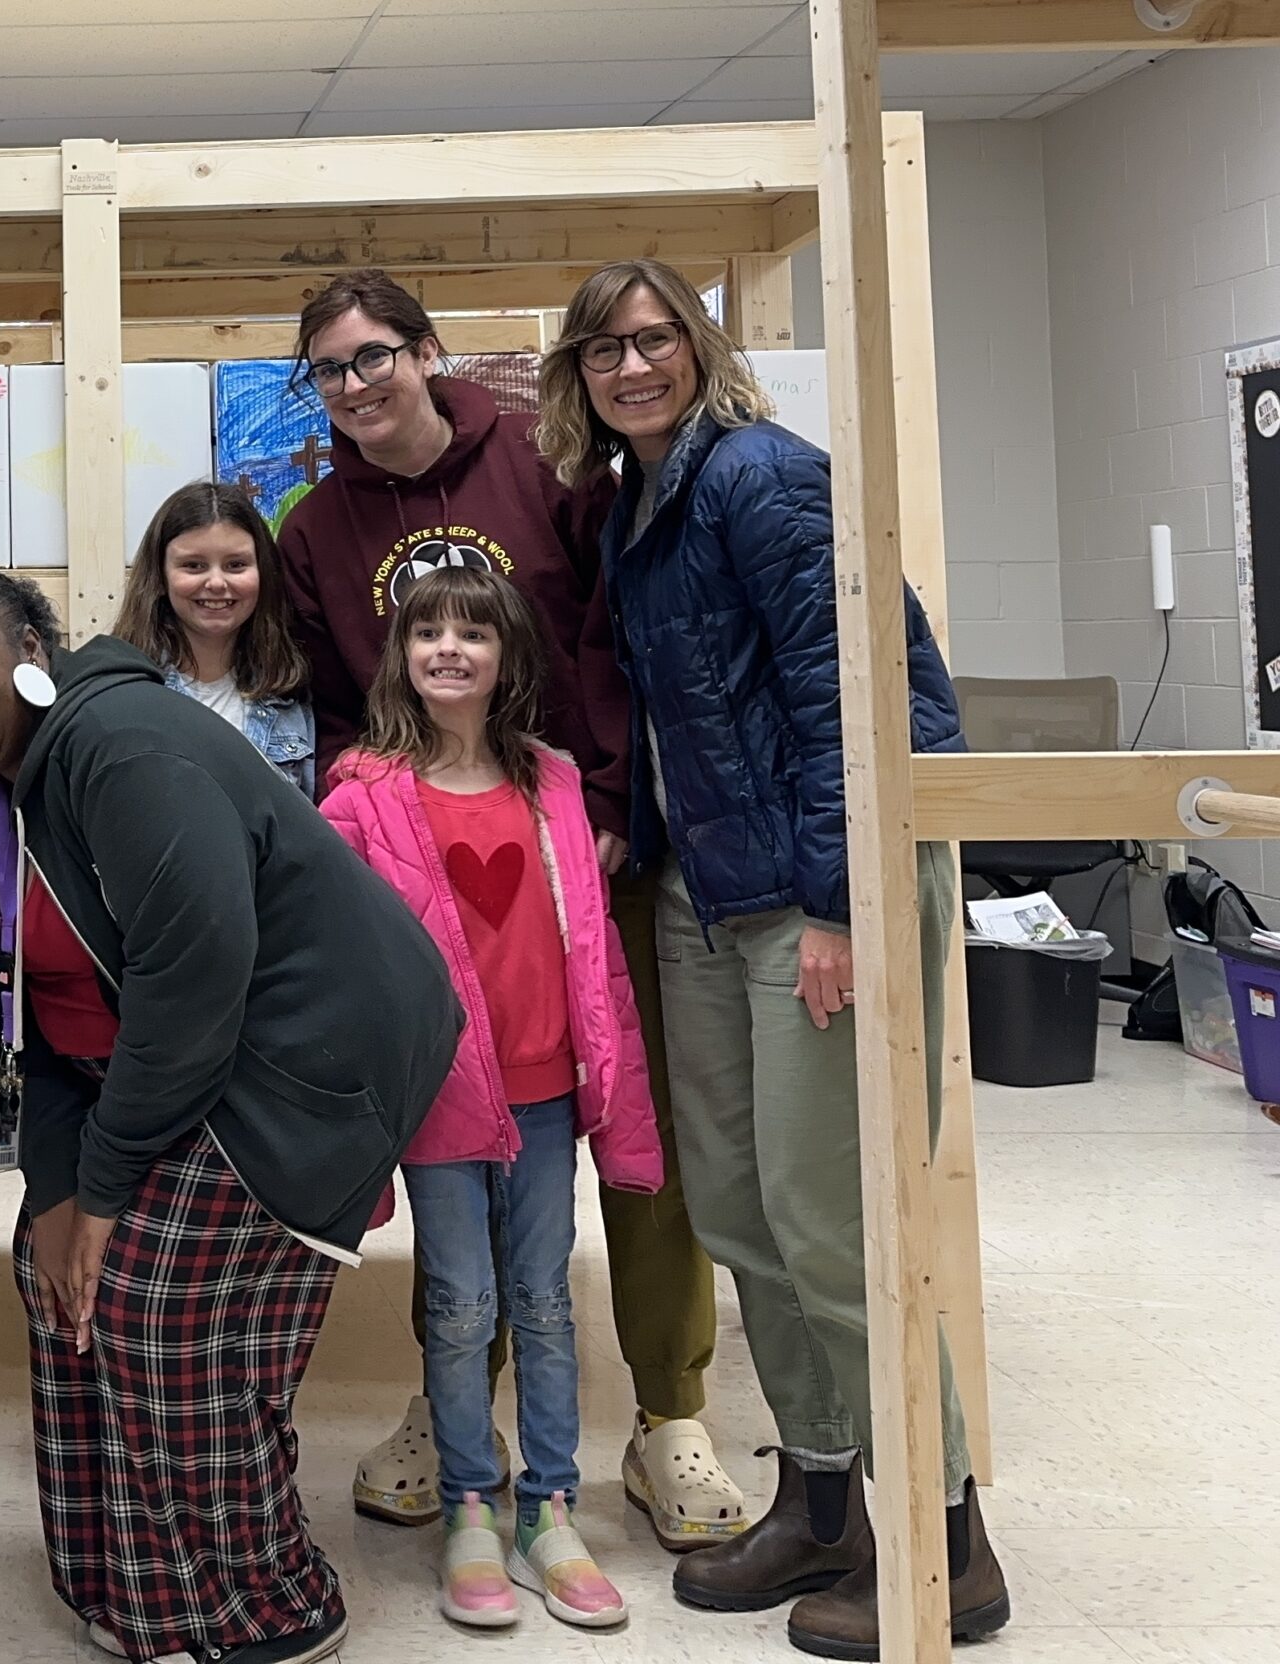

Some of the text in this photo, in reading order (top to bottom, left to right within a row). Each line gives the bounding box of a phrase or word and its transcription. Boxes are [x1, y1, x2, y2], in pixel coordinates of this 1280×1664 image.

[69, 173, 111, 183] Nashville
[394, 528, 431, 553] SATE
[477, 535, 487, 546] &
[373, 552, 397, 583] YORK
[487, 541, 515, 576] WOOL
[372, 586, 386, 617] NEW
